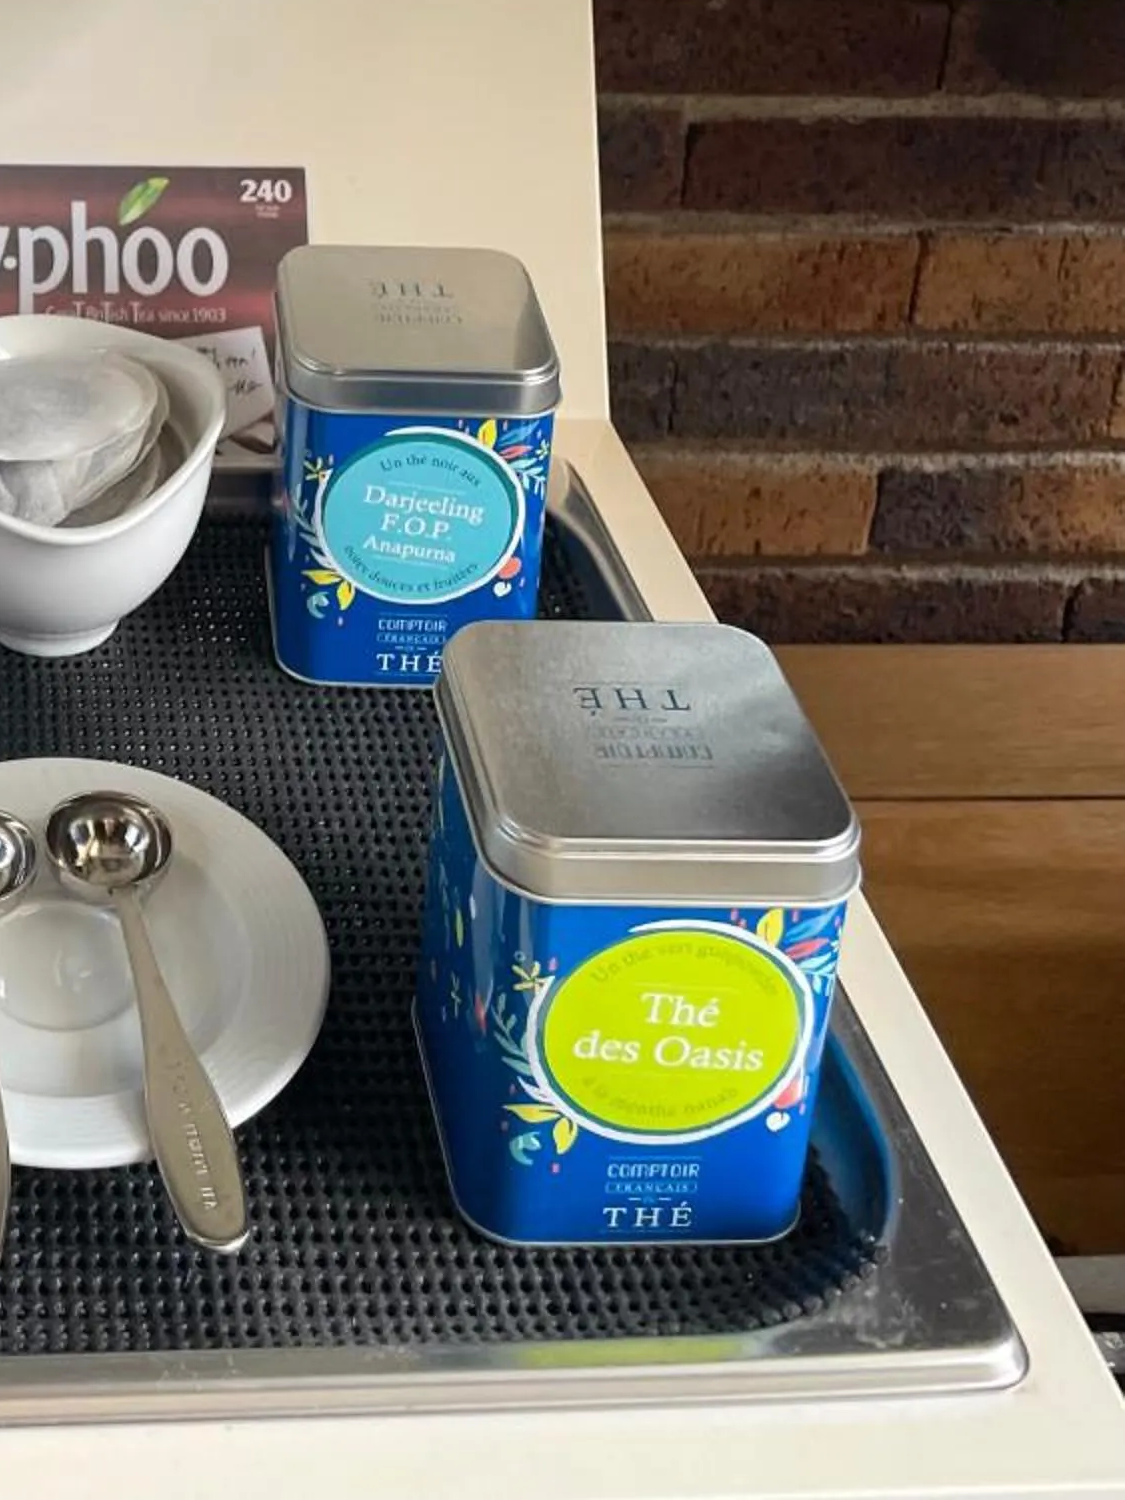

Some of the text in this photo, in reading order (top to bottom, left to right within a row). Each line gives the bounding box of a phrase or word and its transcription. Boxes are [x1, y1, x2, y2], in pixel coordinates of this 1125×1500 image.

[240, 179, 292, 203] 240
[193, 305, 227, 324] 1903
[379, 457, 403, 473] Un
[406, 454, 427, 467] thé
[431, 456, 460, 473] noir
[363, 484, 486, 527] Darjeeling
[381, 512, 453, 541] F.O.P.
[362, 534, 457, 564] Anapurna
[376, 650, 443, 673] THÉ
[573, 686, 691, 717] THÉ
[640, 991, 721, 1028] Thé
[572, 1029, 765, 1072] des Oasis
[607, 1163, 701, 1179] COMPTOIR
[602, 1200, 693, 1228] THÉ
